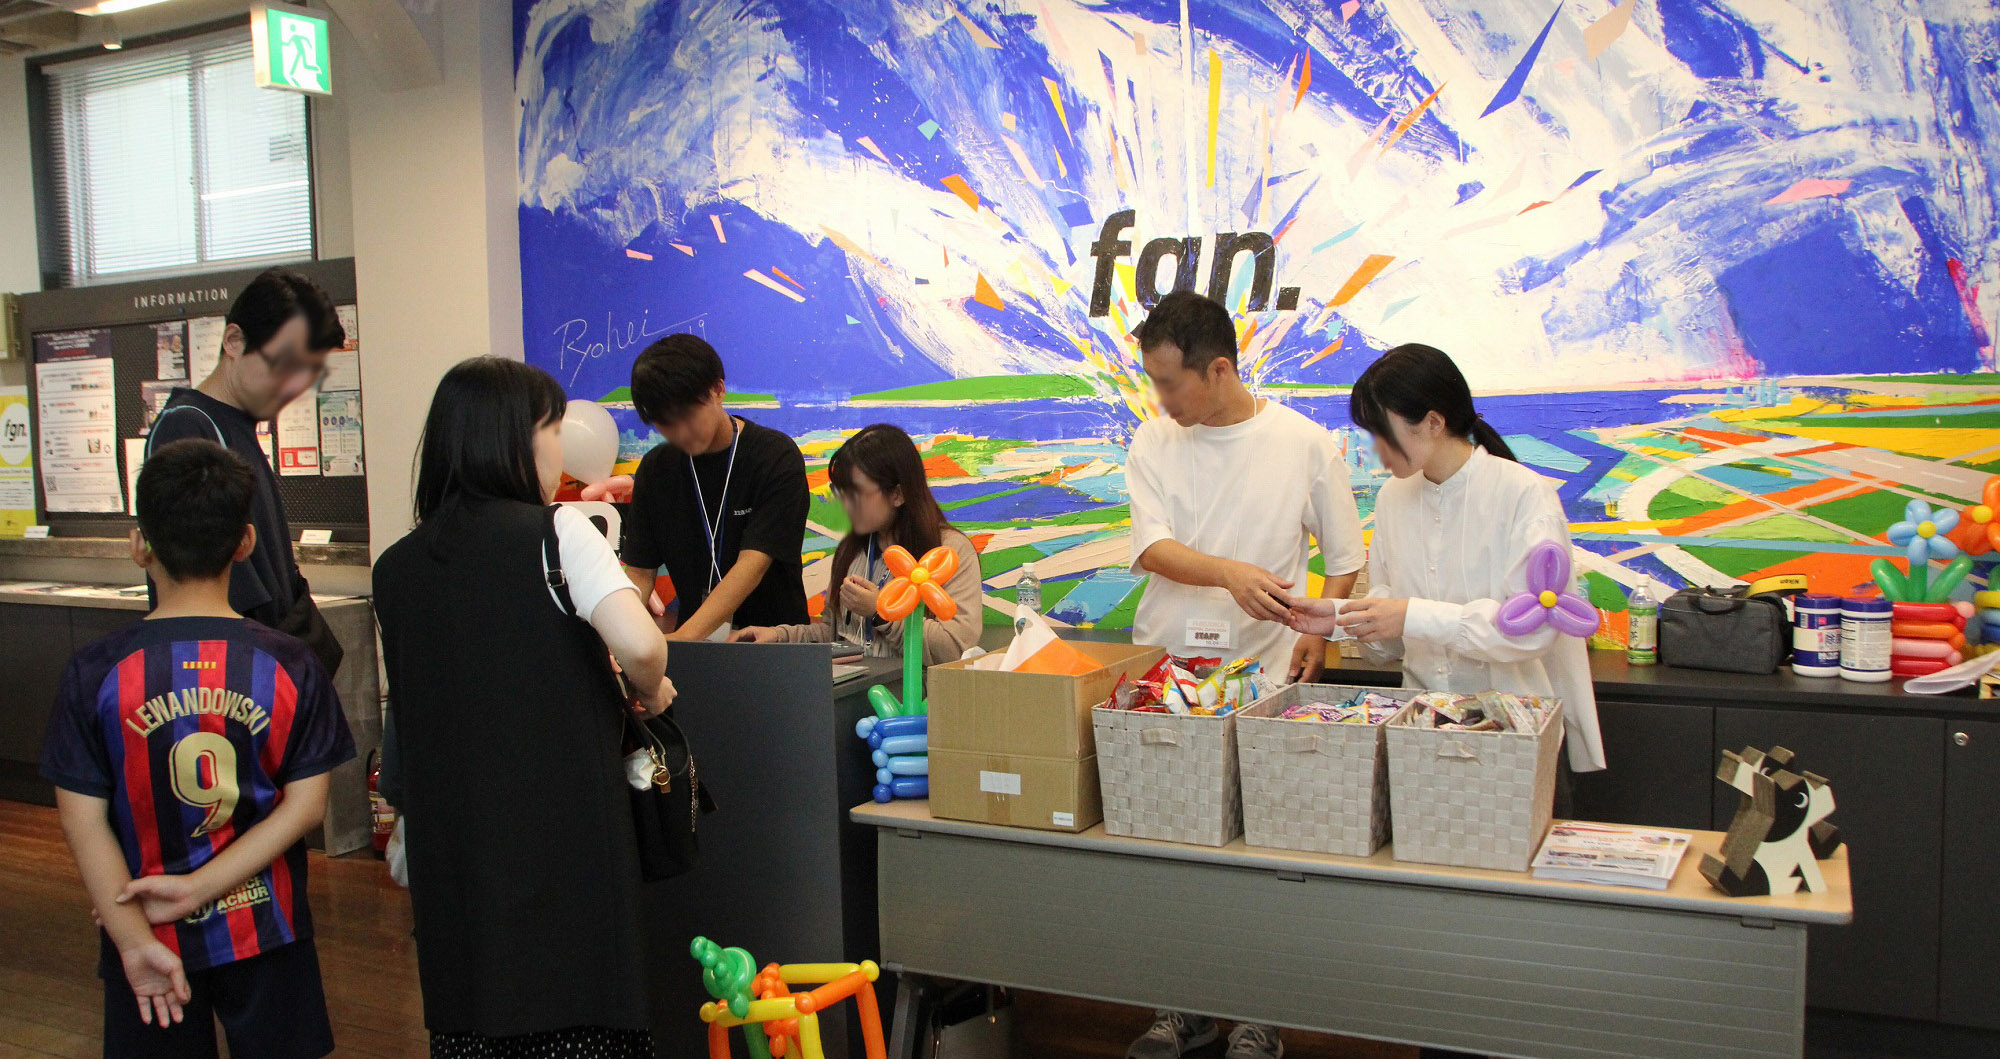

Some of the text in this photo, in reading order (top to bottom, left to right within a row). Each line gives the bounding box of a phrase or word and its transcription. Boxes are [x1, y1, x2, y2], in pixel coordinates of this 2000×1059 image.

[134, 287, 228, 309] INFORMATION
[126, 687, 270, 737] LEWANDOWSKI
[168, 731, 240, 838] 9
[217, 886, 268, 910] ACNUR
